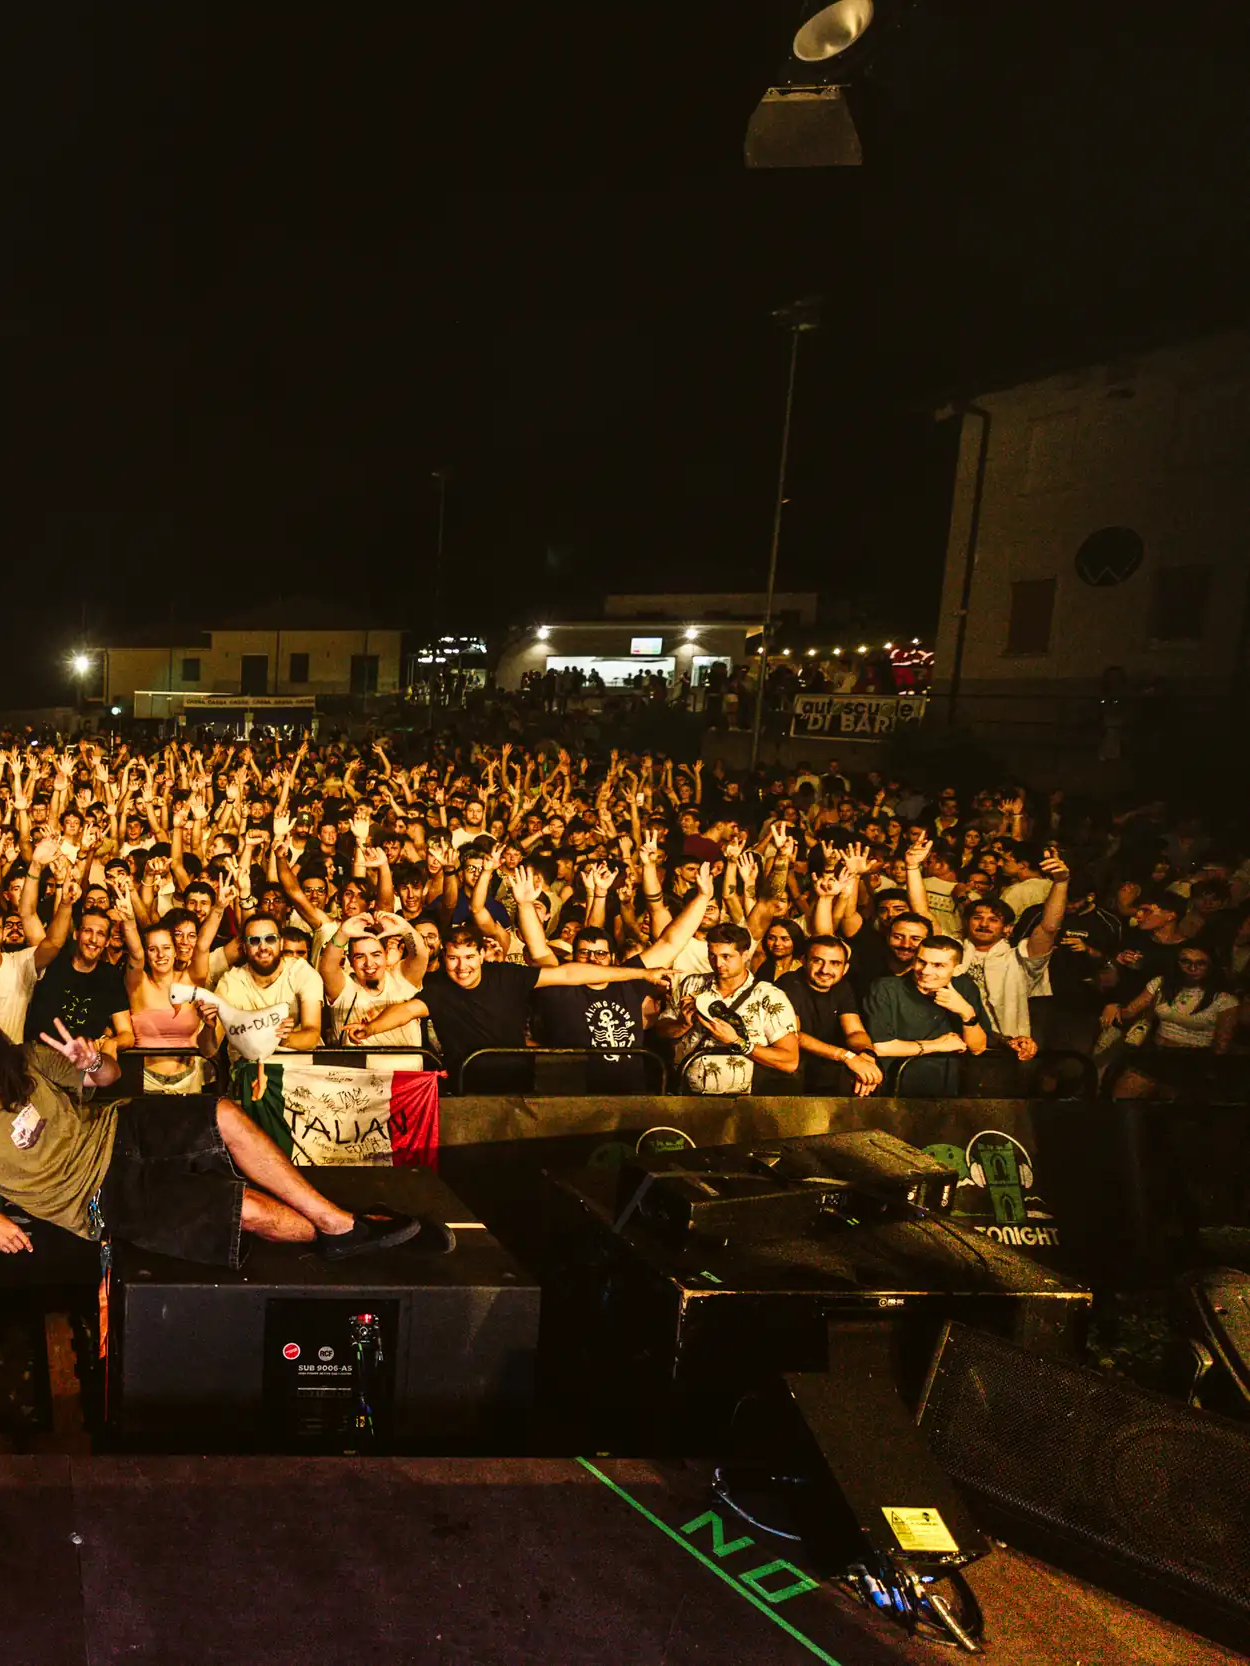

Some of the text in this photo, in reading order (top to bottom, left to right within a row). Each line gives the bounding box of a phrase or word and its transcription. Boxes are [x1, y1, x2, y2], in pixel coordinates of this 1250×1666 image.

[229, 1013, 280, 1035] OCA-DUB
[298, 1364, 353, 1372] SUB 9006-AS
